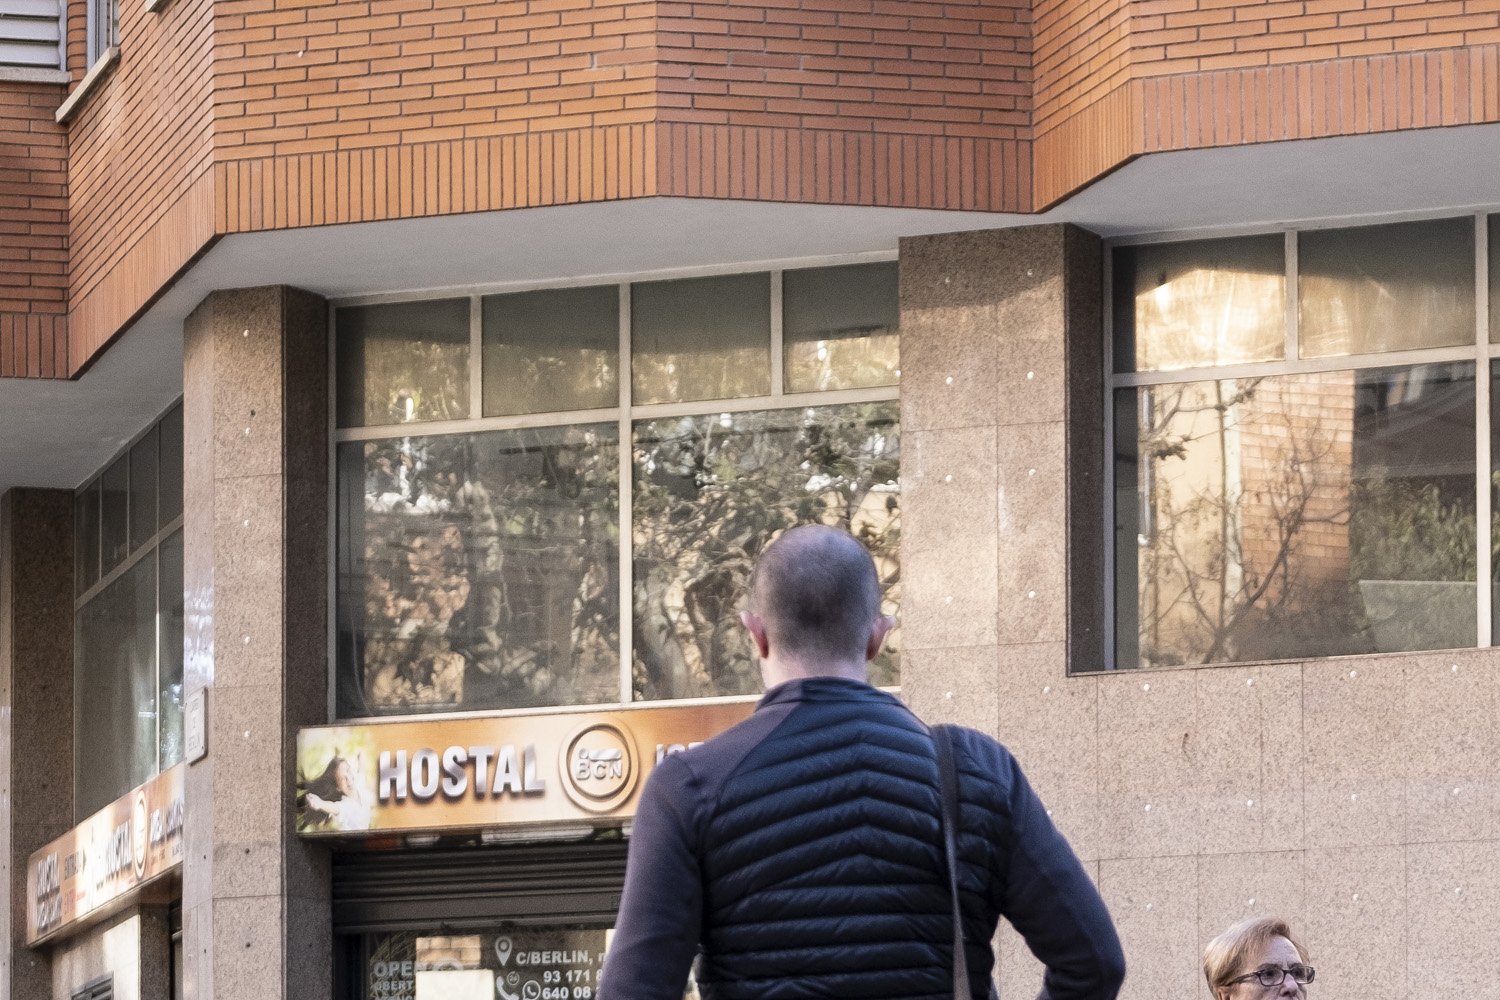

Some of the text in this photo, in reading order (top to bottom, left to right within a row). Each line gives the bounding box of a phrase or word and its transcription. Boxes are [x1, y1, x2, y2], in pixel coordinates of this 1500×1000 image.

[379, 744, 546, 799] HOSTAL
[576, 760, 622, 780] BCN
[516, 951, 593, 965] C/BERLIN,
[543, 970, 561, 983] 93
[566, 969, 590, 983] 171
[542, 985, 591, 1000] 640 08
